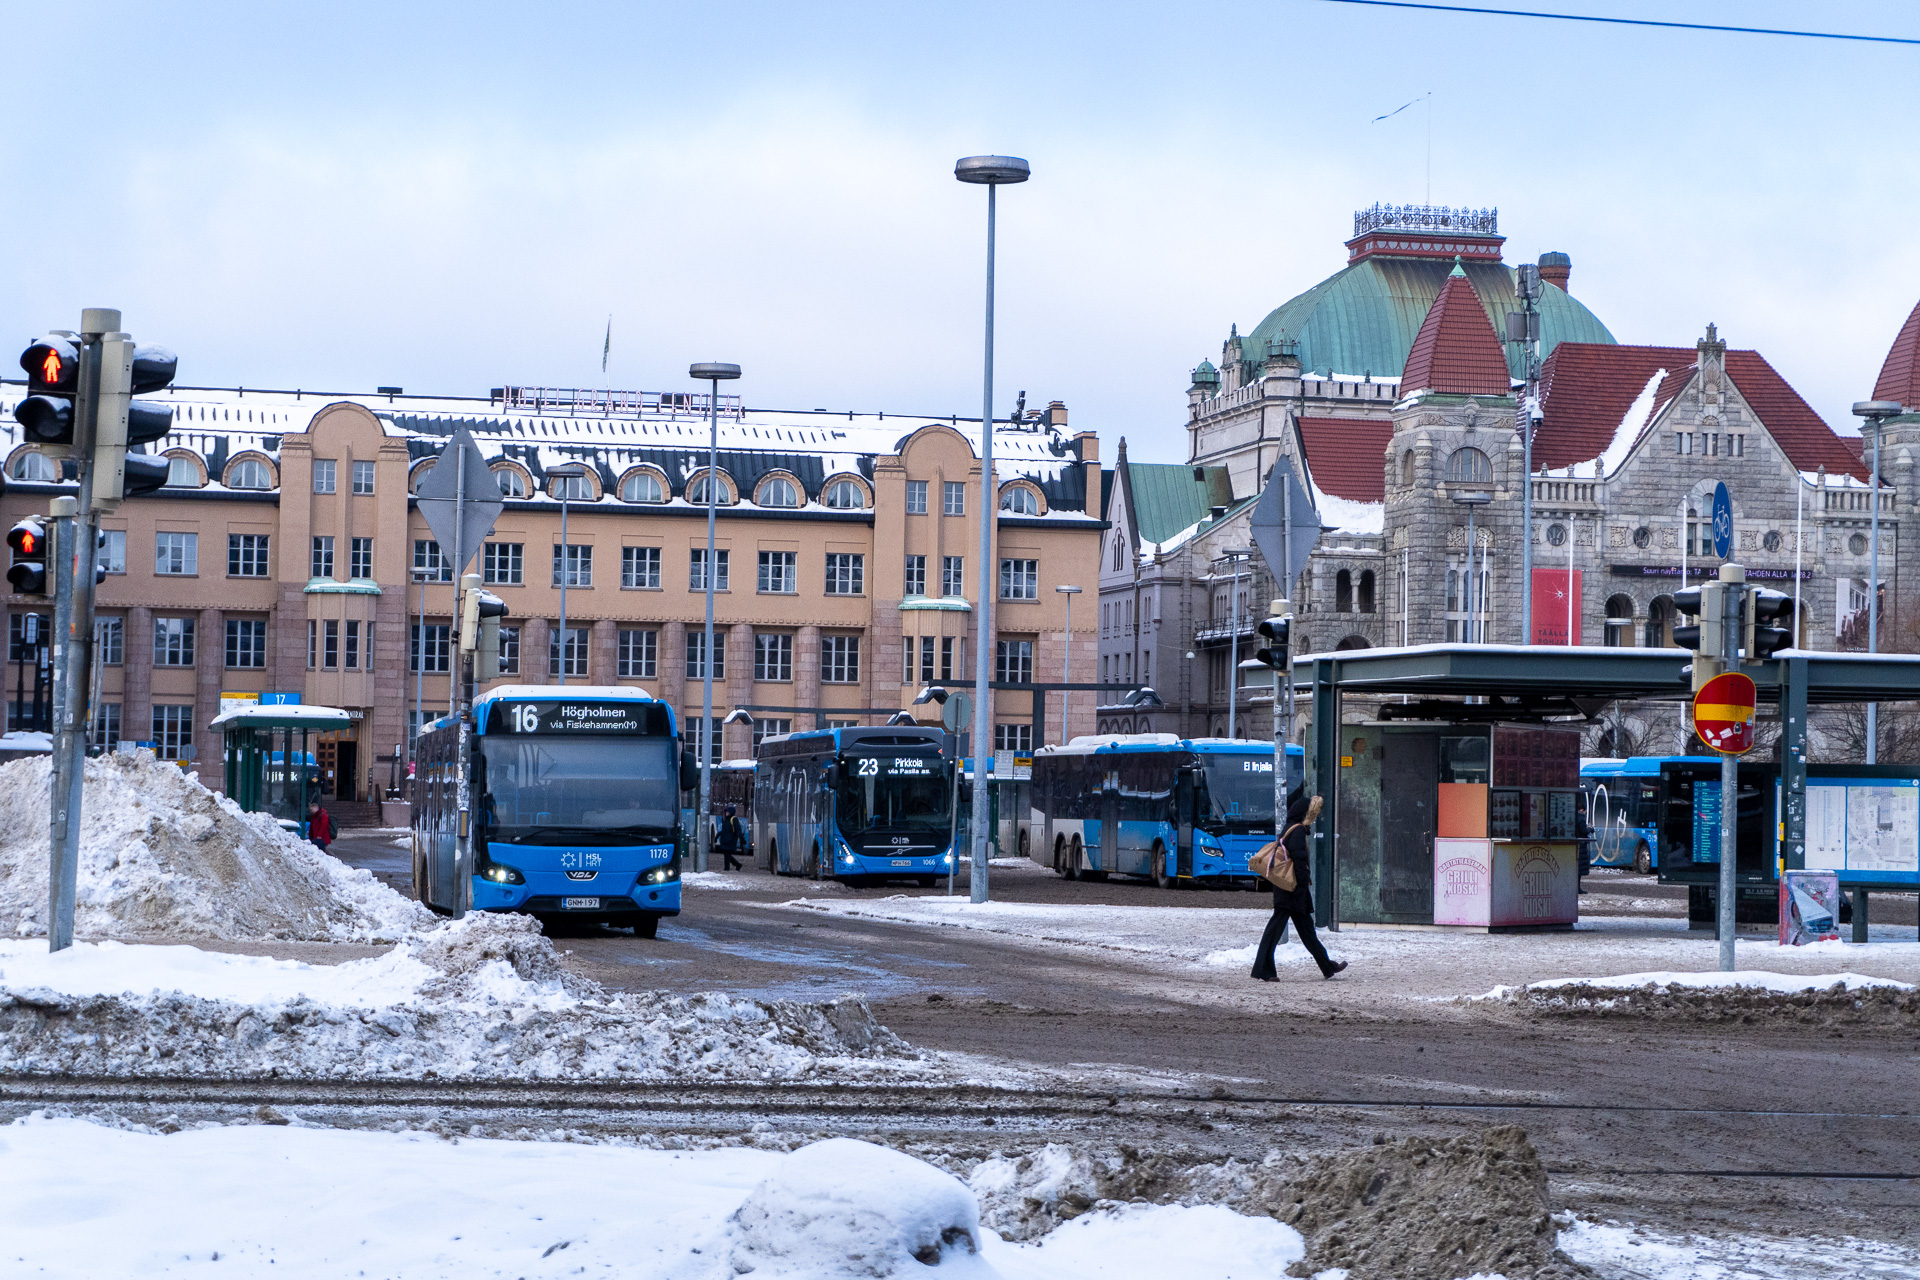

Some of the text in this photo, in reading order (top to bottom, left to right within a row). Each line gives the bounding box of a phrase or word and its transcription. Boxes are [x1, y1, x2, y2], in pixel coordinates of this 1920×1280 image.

[502, 385, 562, 410] HOTEL
[576, 387, 644, 414] GRAND
[275, 694, 286, 705] 17
[511, 704, 539, 732] 16
[561, 705, 626, 719] Högholmen
[550, 720, 638, 730] via Fiskehamnen(M)
[858, 758, 879, 776] 23
[894, 757, 923, 768] Pirkkola
[649, 848, 668, 859] 1178
[585, 859, 602, 867] HRT
[1446, 870, 1478, 883] GRILLI
[1447, 883, 1478, 895] KIOSKI
[1523, 871, 1551, 896] GRILLI
[1523, 897, 1551, 918] KIOSKI
